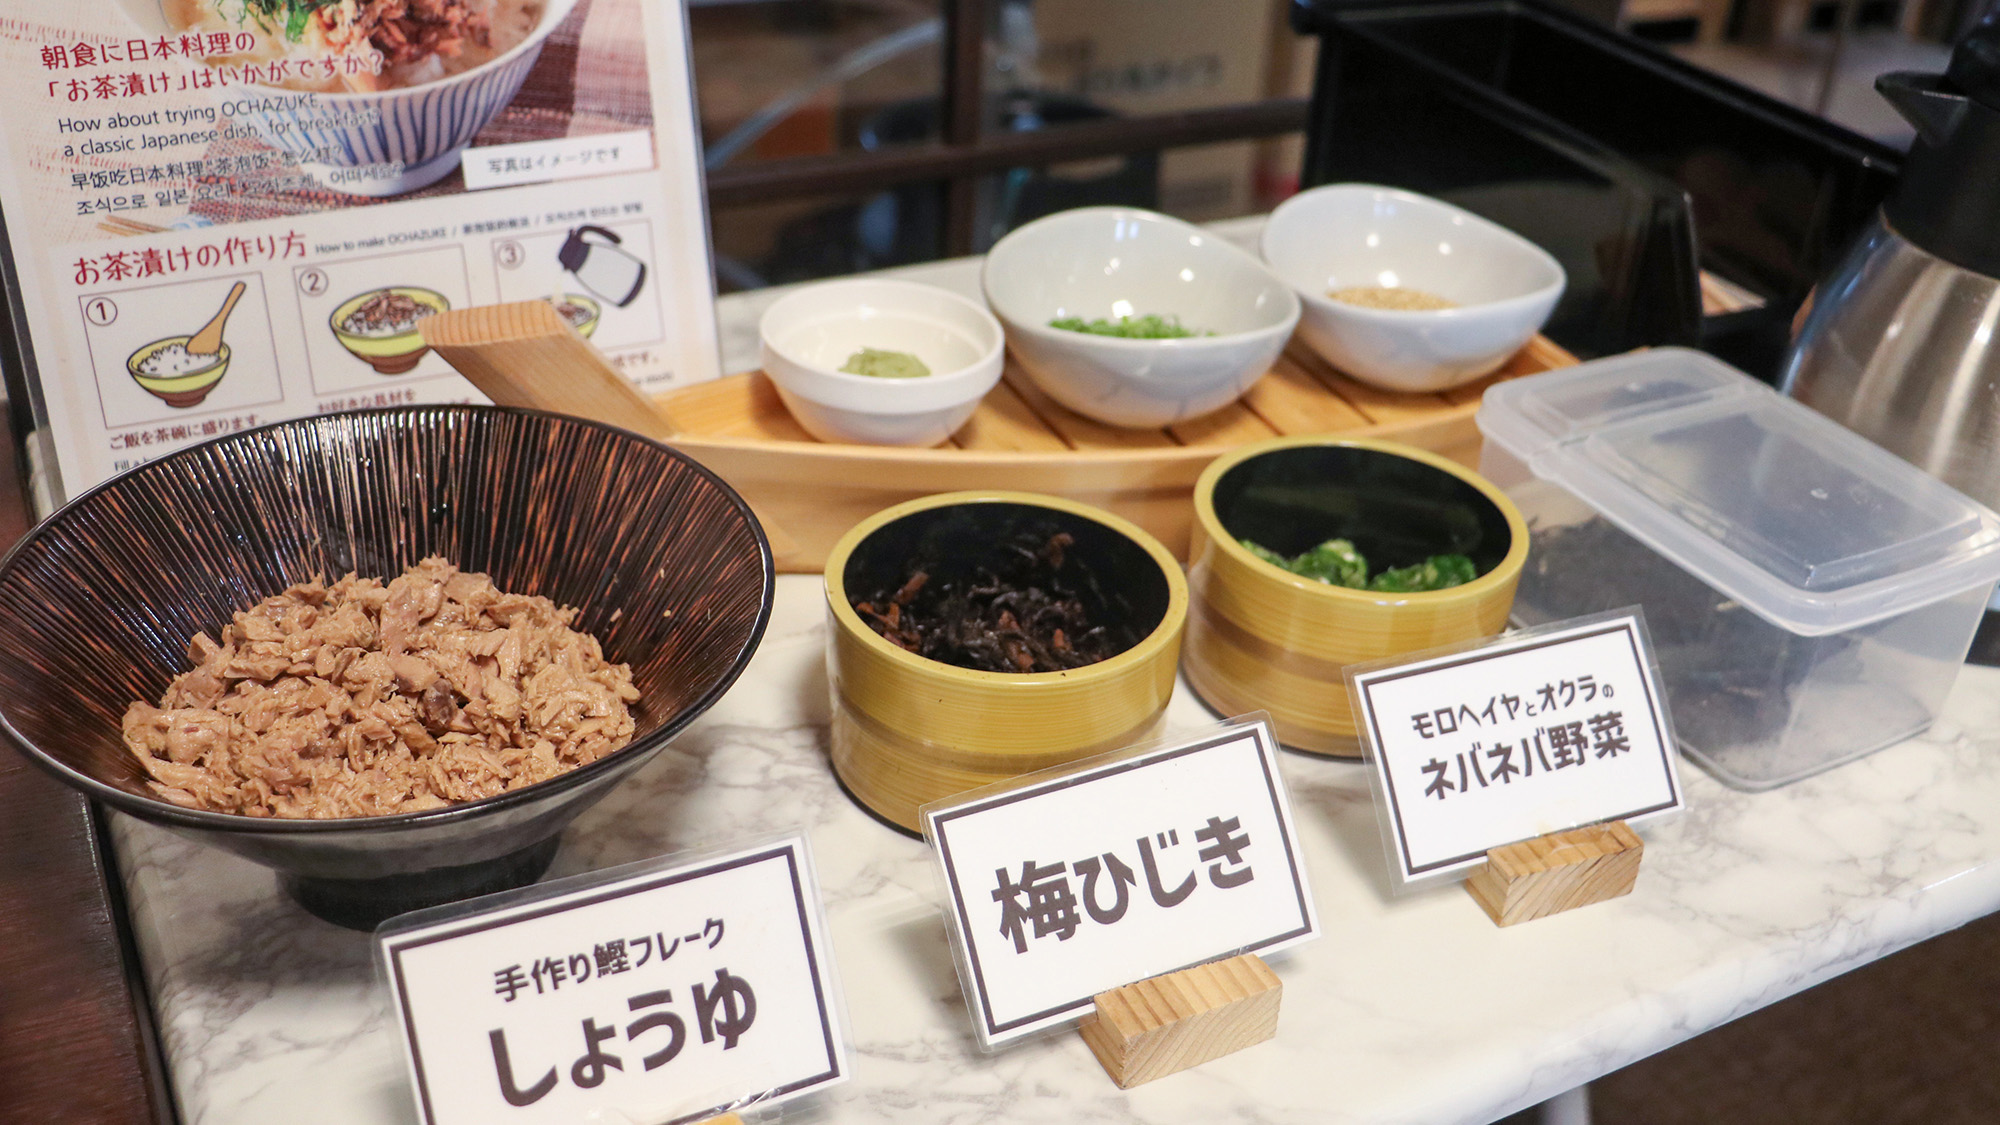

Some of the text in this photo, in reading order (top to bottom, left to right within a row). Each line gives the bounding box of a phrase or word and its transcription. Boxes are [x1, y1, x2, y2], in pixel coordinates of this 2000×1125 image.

[41, 31, 256, 70] 朝食に日本料理の
[59, 94, 324, 134] How about trying OCHAZUKE,
[64, 109, 382, 157] a classic Japanese dish, for breakfast?
[488, 147, 621, 174] 写真はイメージです
[77, 193, 148, 216] 조식으로
[155, 188, 189, 207] 일본
[197, 183, 232, 201] 요리
[72, 230, 306, 286] お茶漬けの作り方
[315, 242, 341, 254] How
[343, 240, 354, 250] to
[357, 237, 385, 249] make
[388, 227, 446, 244] OCHAZUKE
[1410, 675, 1614, 739] モロヘイヤとオクラの
[1421, 711, 1631, 801] ネバネバ野菜
[991, 816, 1254, 955] 梅ひじき
[494, 918, 726, 1002] 手作り鰹フレーク
[489, 967, 757, 1107] しょうゆ
